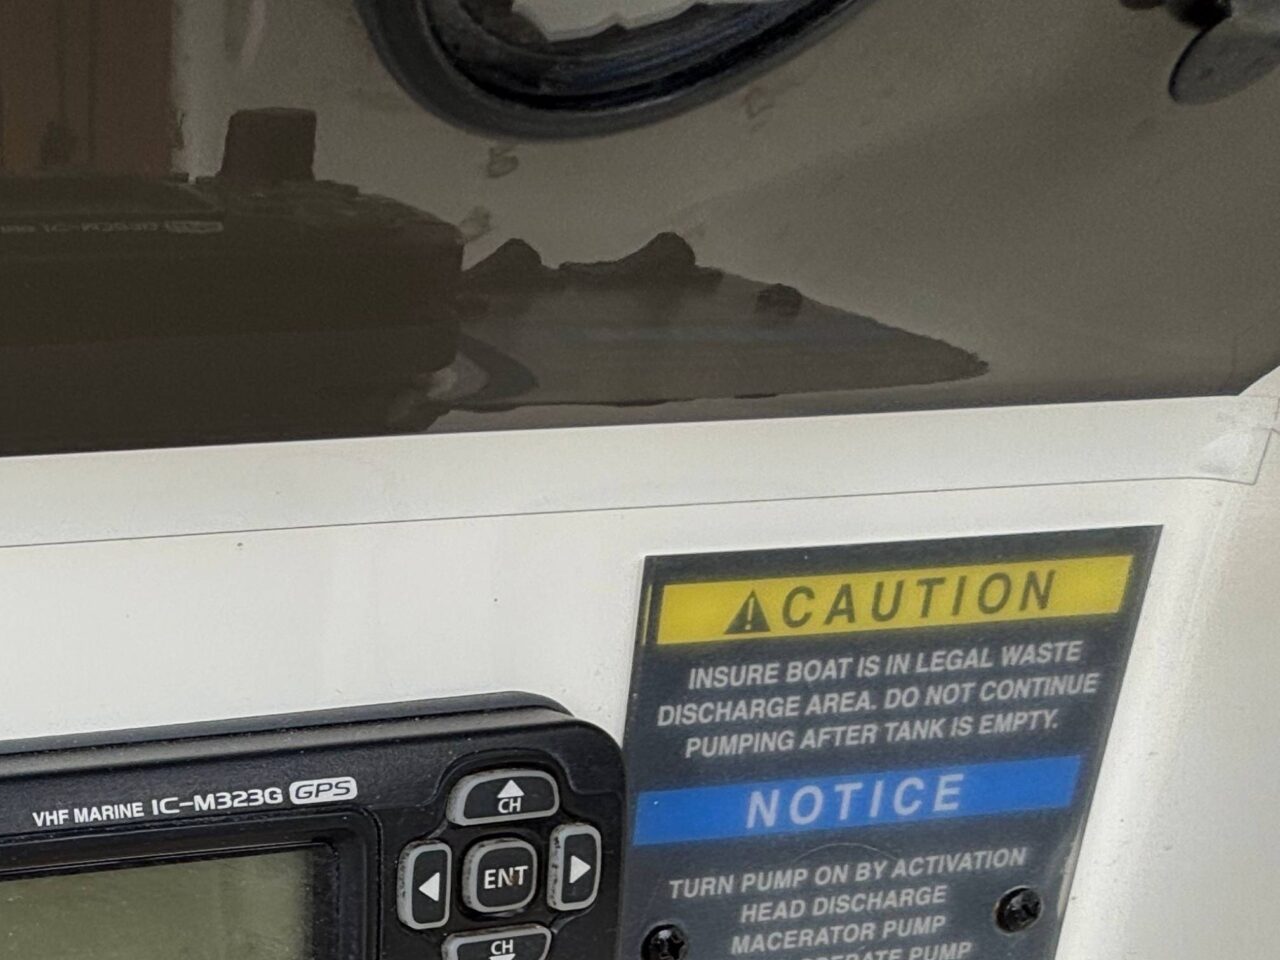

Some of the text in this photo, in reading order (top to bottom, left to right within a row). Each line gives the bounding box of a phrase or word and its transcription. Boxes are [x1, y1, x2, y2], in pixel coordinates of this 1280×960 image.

[781, 569, 1057, 629] CAUTION
[689, 640, 1083, 690] INSURE BOAT IS IN LEGAL WASTE
[657, 673, 1100, 726] DISCHARGE AREA. DO NOT CONTINUE
[685, 709, 1059, 758] PUMPING AFTER TANK IS EMPTY.
[32, 778, 353, 827] VHF MARINE IC-M323G GPS
[497, 798, 522, 814] CH
[746, 773, 966, 829] NOTICE
[483, 865, 528, 890] ENT
[670, 847, 1028, 899] TURN PUMP ON BY ACTIVATION
[740, 885, 948, 924] HEAD DISCHARGE
[490, 940, 514, 955] CH
[730, 915, 947, 955] MACERATOR PUMP
